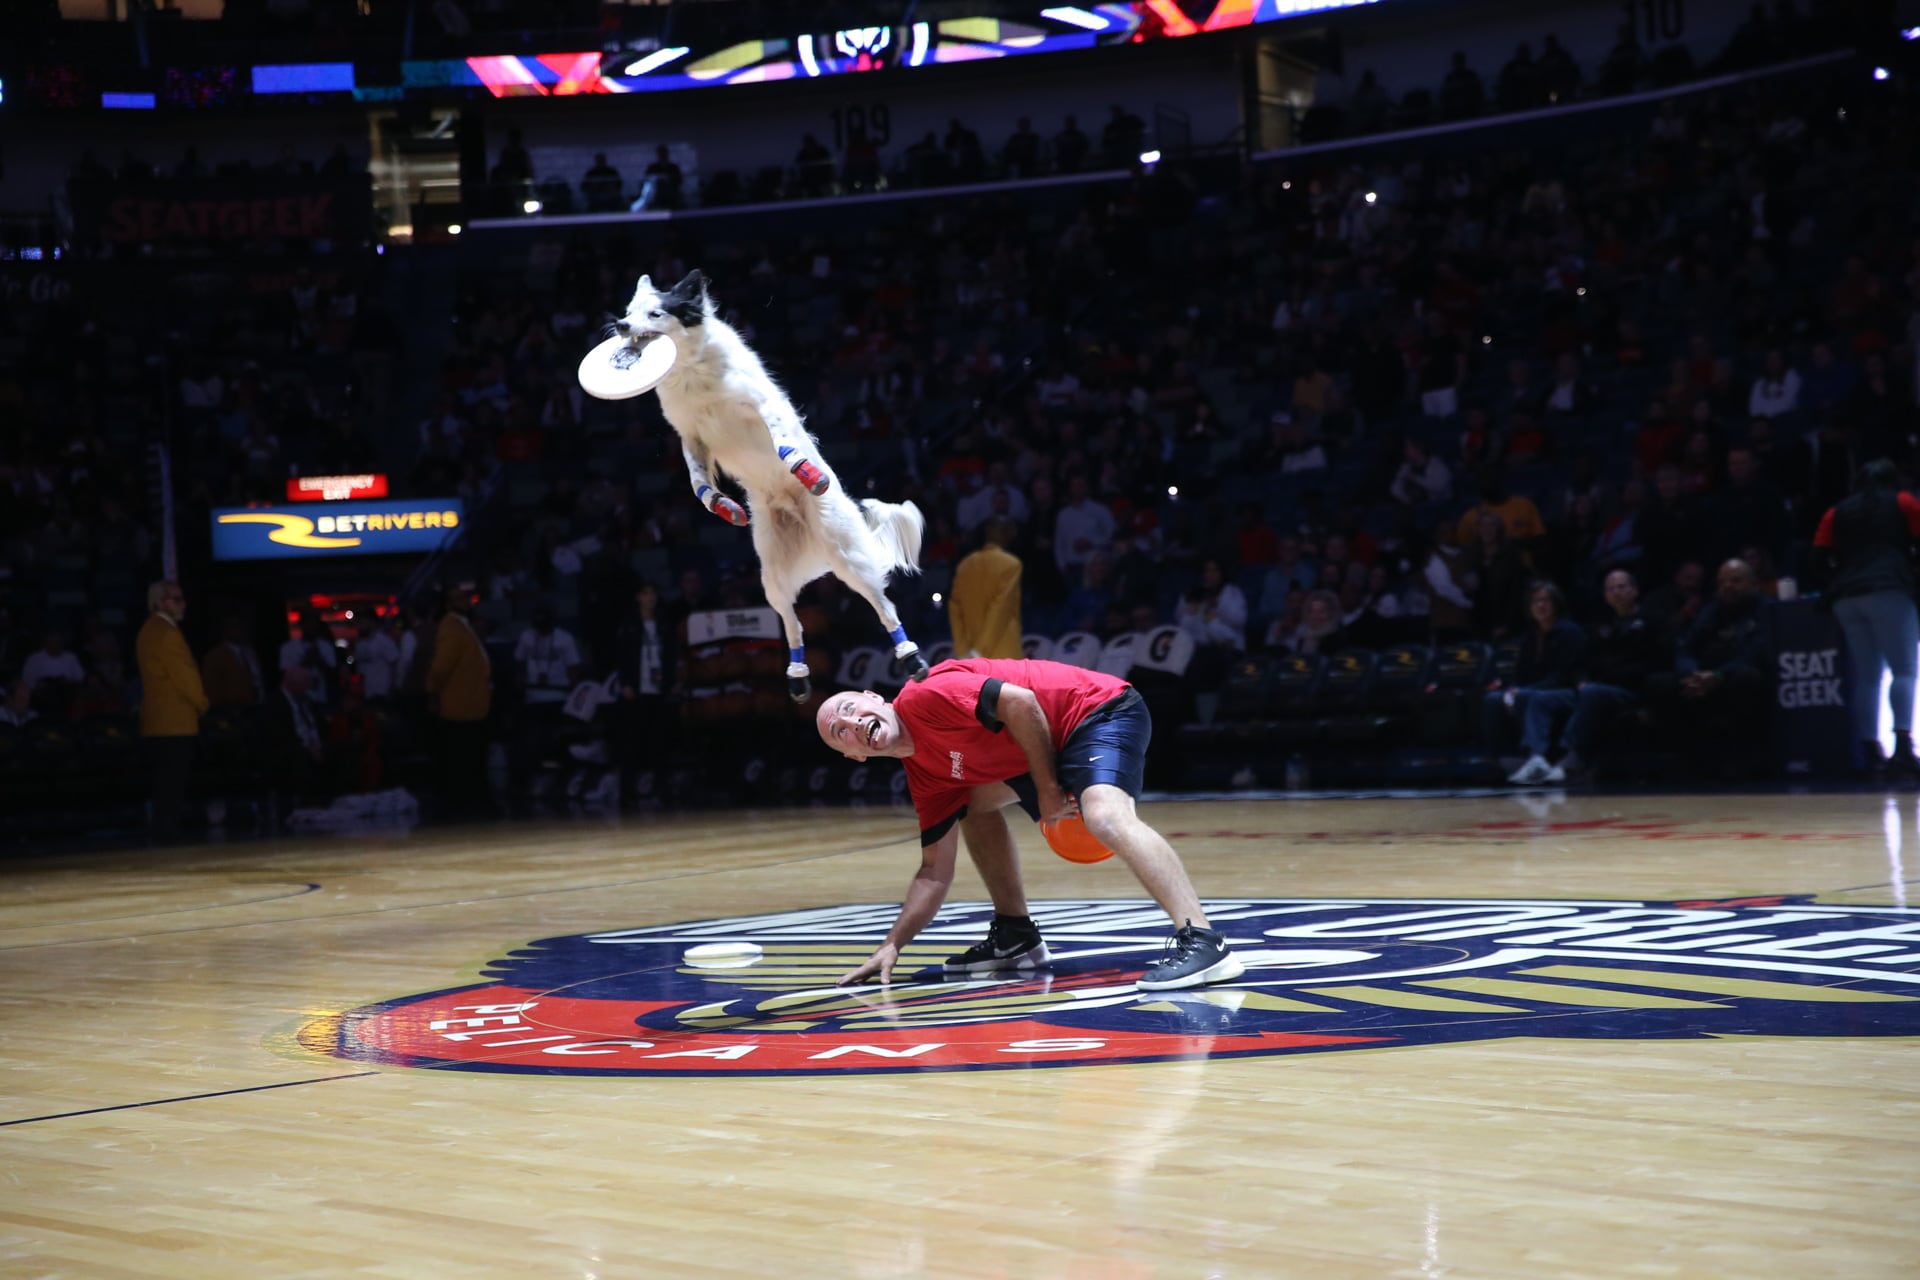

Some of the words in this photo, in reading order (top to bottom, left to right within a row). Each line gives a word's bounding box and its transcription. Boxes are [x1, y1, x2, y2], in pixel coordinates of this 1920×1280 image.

[829, 103, 889, 149] 109
[110, 194, 336, 242] SEATGEEK
[317, 510, 459, 533] BETRIVERS
[1778, 649, 1838, 679] SEAT
[1778, 679, 1845, 708] GEEK
[430, 1002, 1110, 1060] PELICANS
